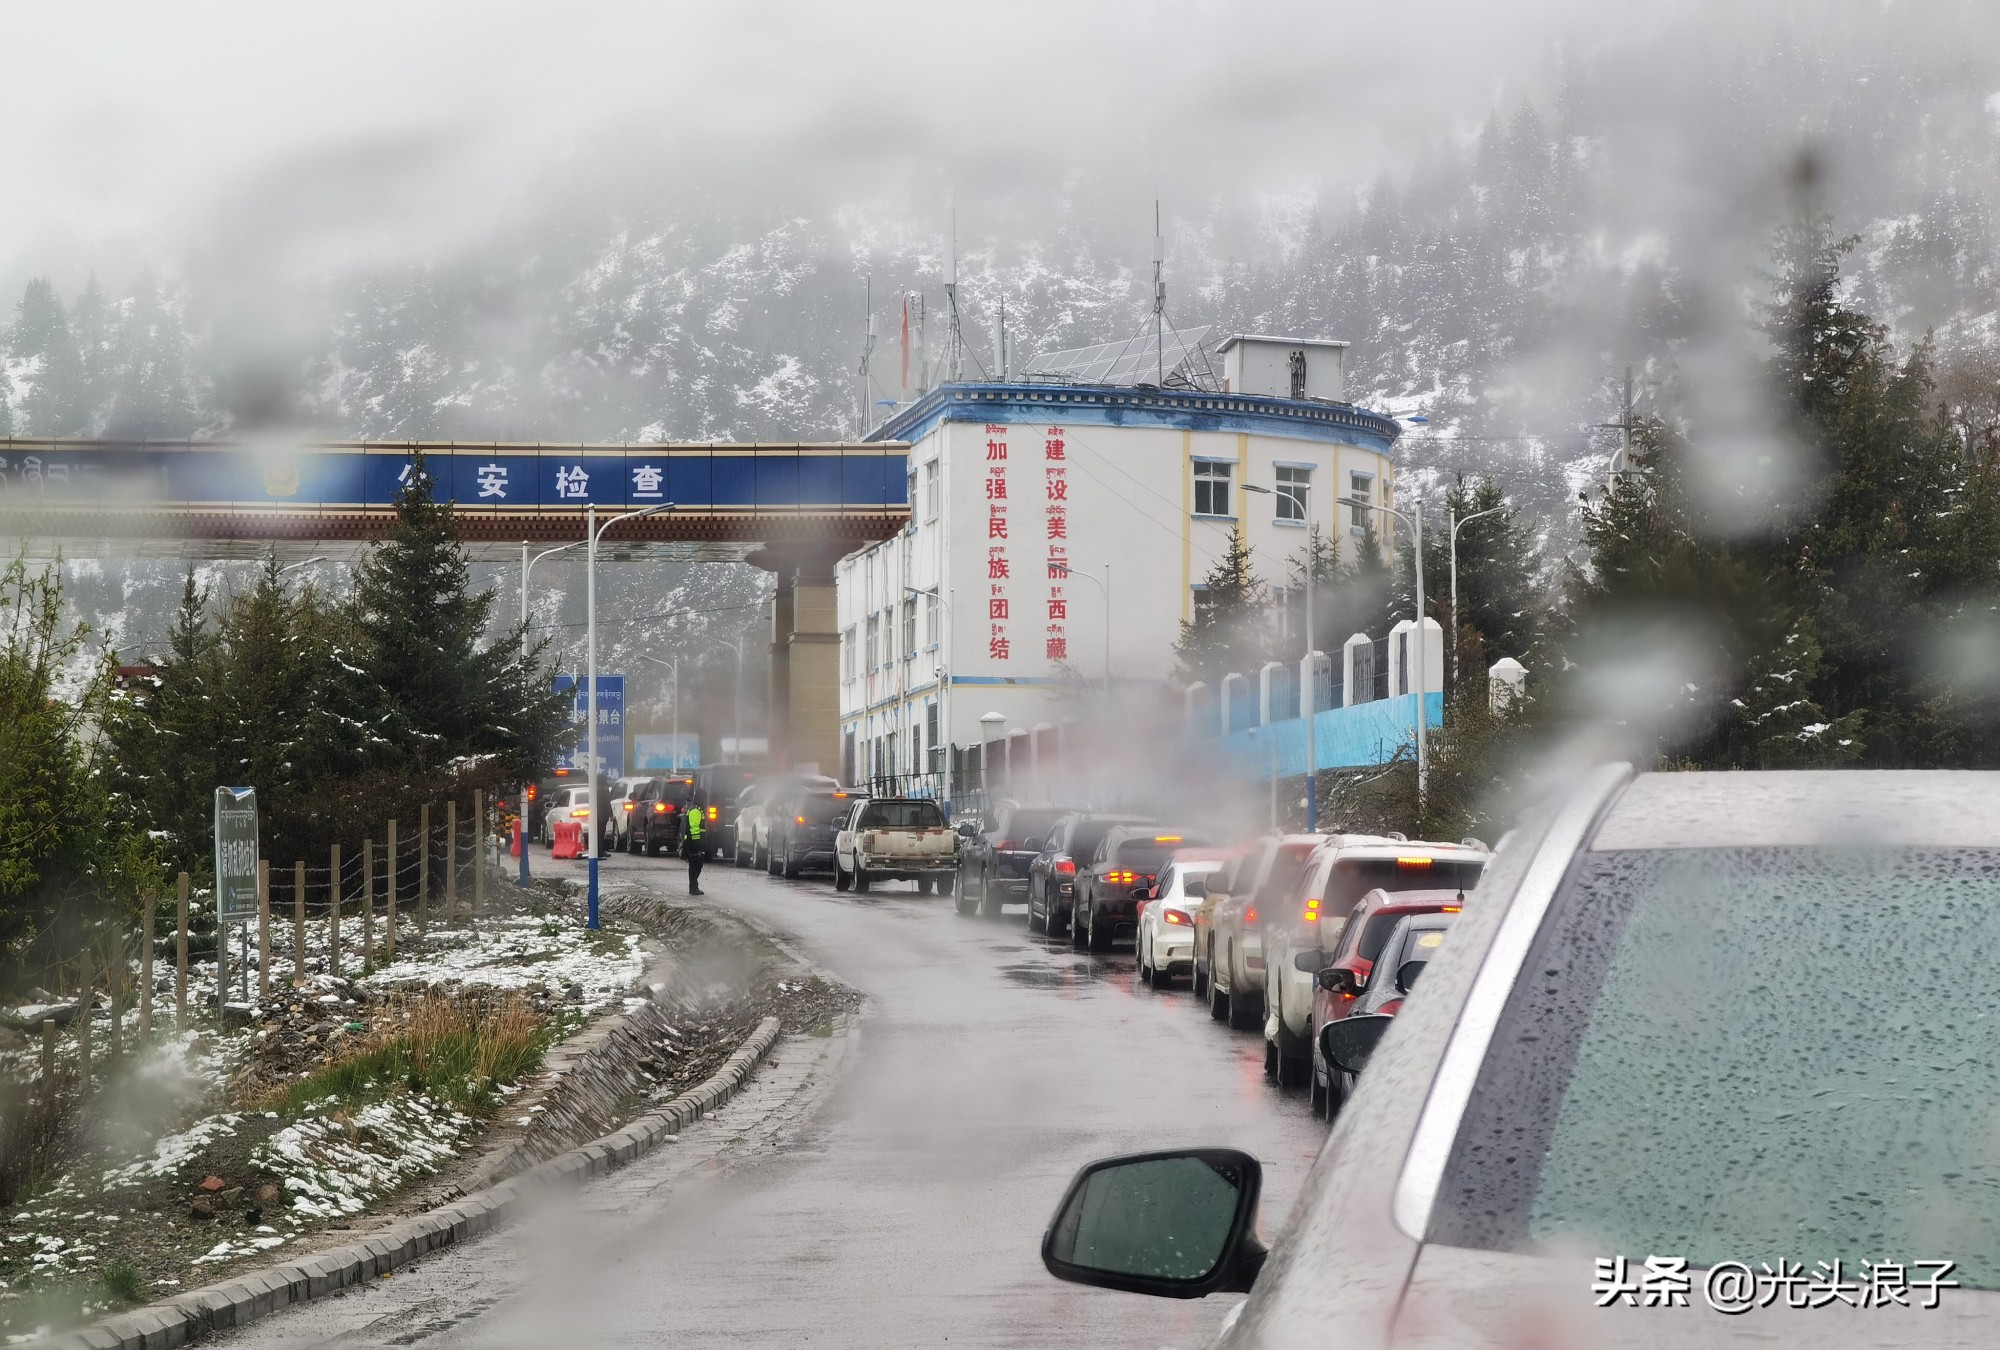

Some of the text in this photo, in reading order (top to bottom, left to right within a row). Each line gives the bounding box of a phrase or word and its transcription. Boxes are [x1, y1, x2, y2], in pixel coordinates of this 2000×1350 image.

[986, 439, 1010, 660] 加强民族团结
[1046, 439, 1068, 660] 建设美丽西藏
